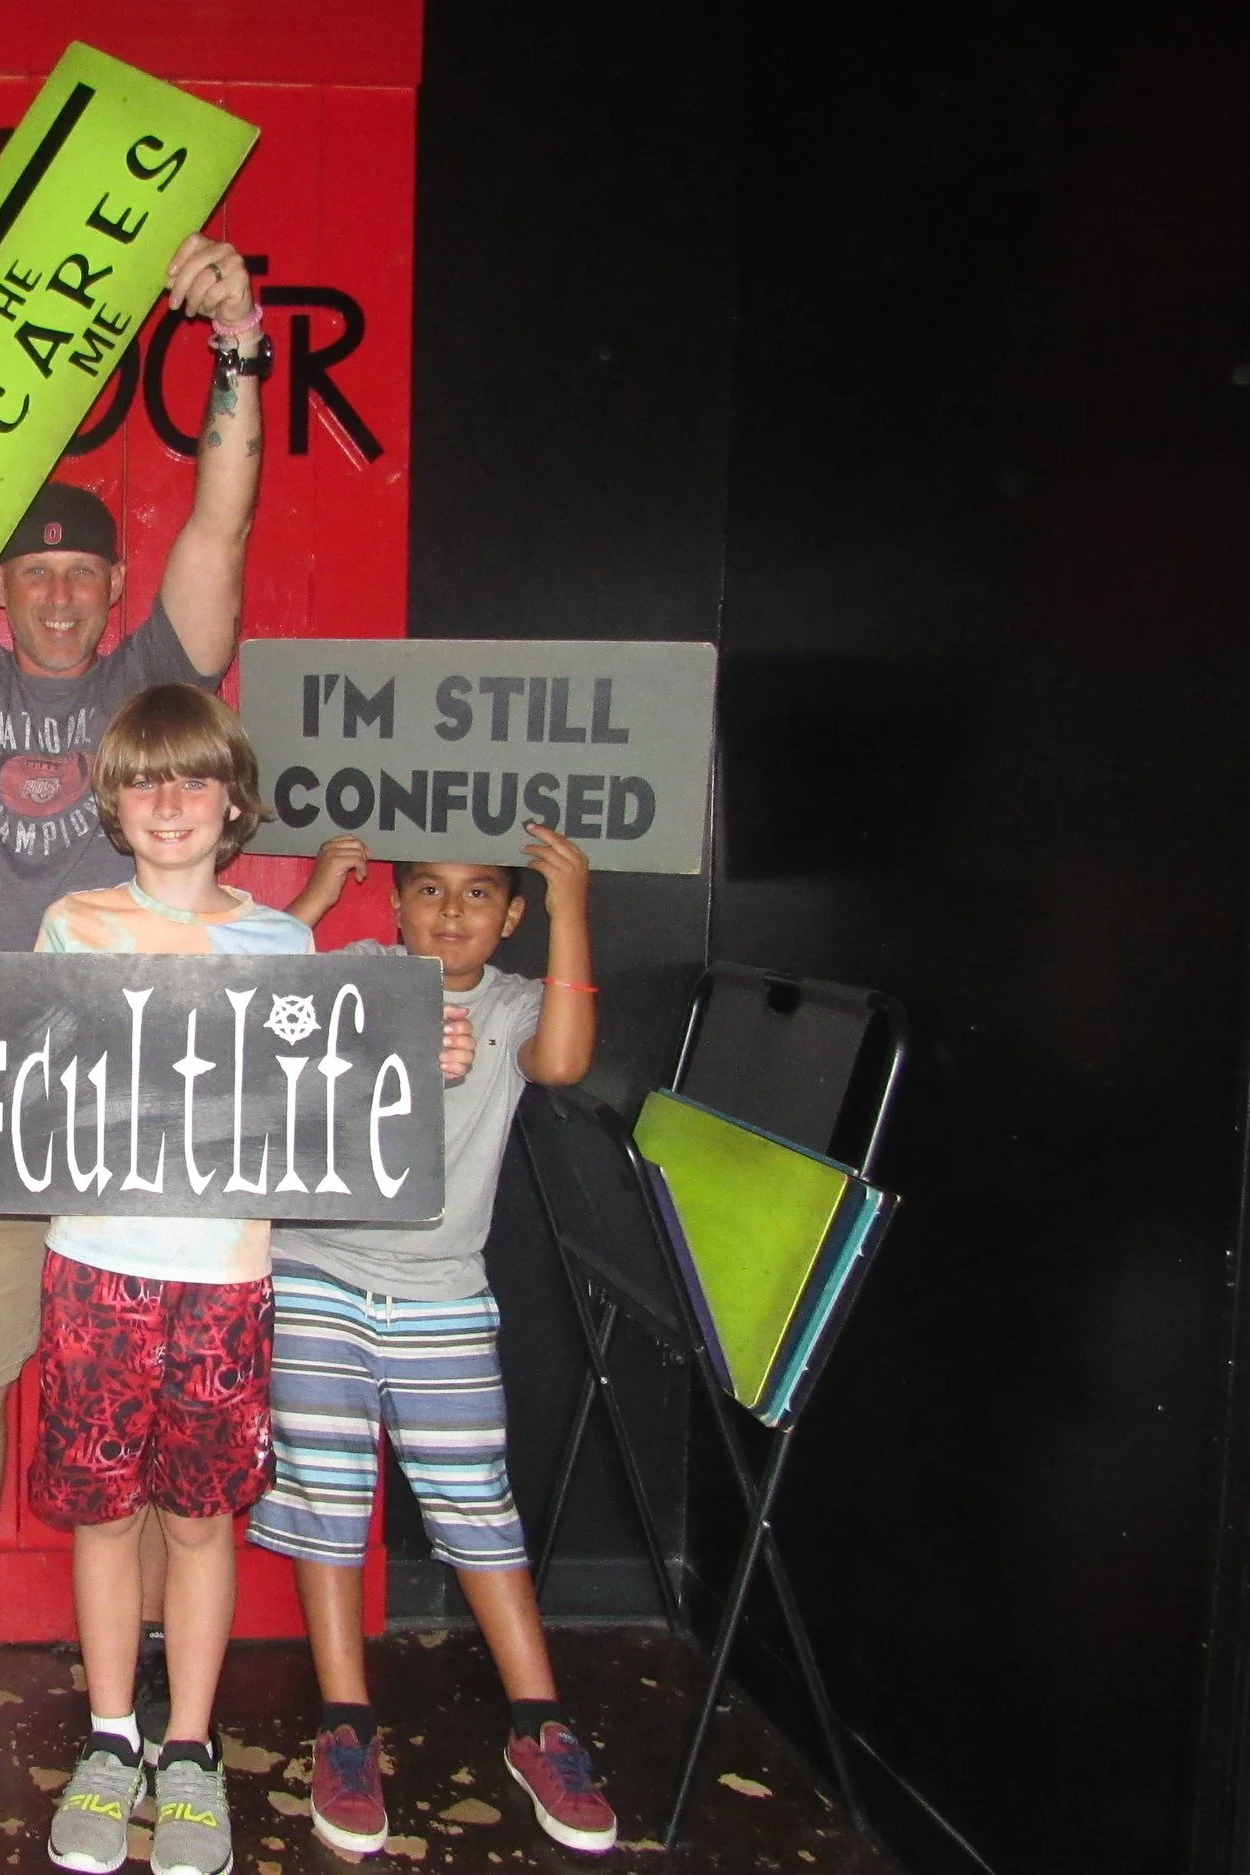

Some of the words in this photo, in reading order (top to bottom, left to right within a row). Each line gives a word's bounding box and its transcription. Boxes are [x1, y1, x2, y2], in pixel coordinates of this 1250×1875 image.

[68, 307, 133, 376] ME
[303, 674, 395, 739] I'M
[434, 675, 630, 744] STILL
[274, 765, 656, 840] CONFUSED
[63, 1794, 123, 1820] FILA
[158, 1802, 218, 1828] FILA
